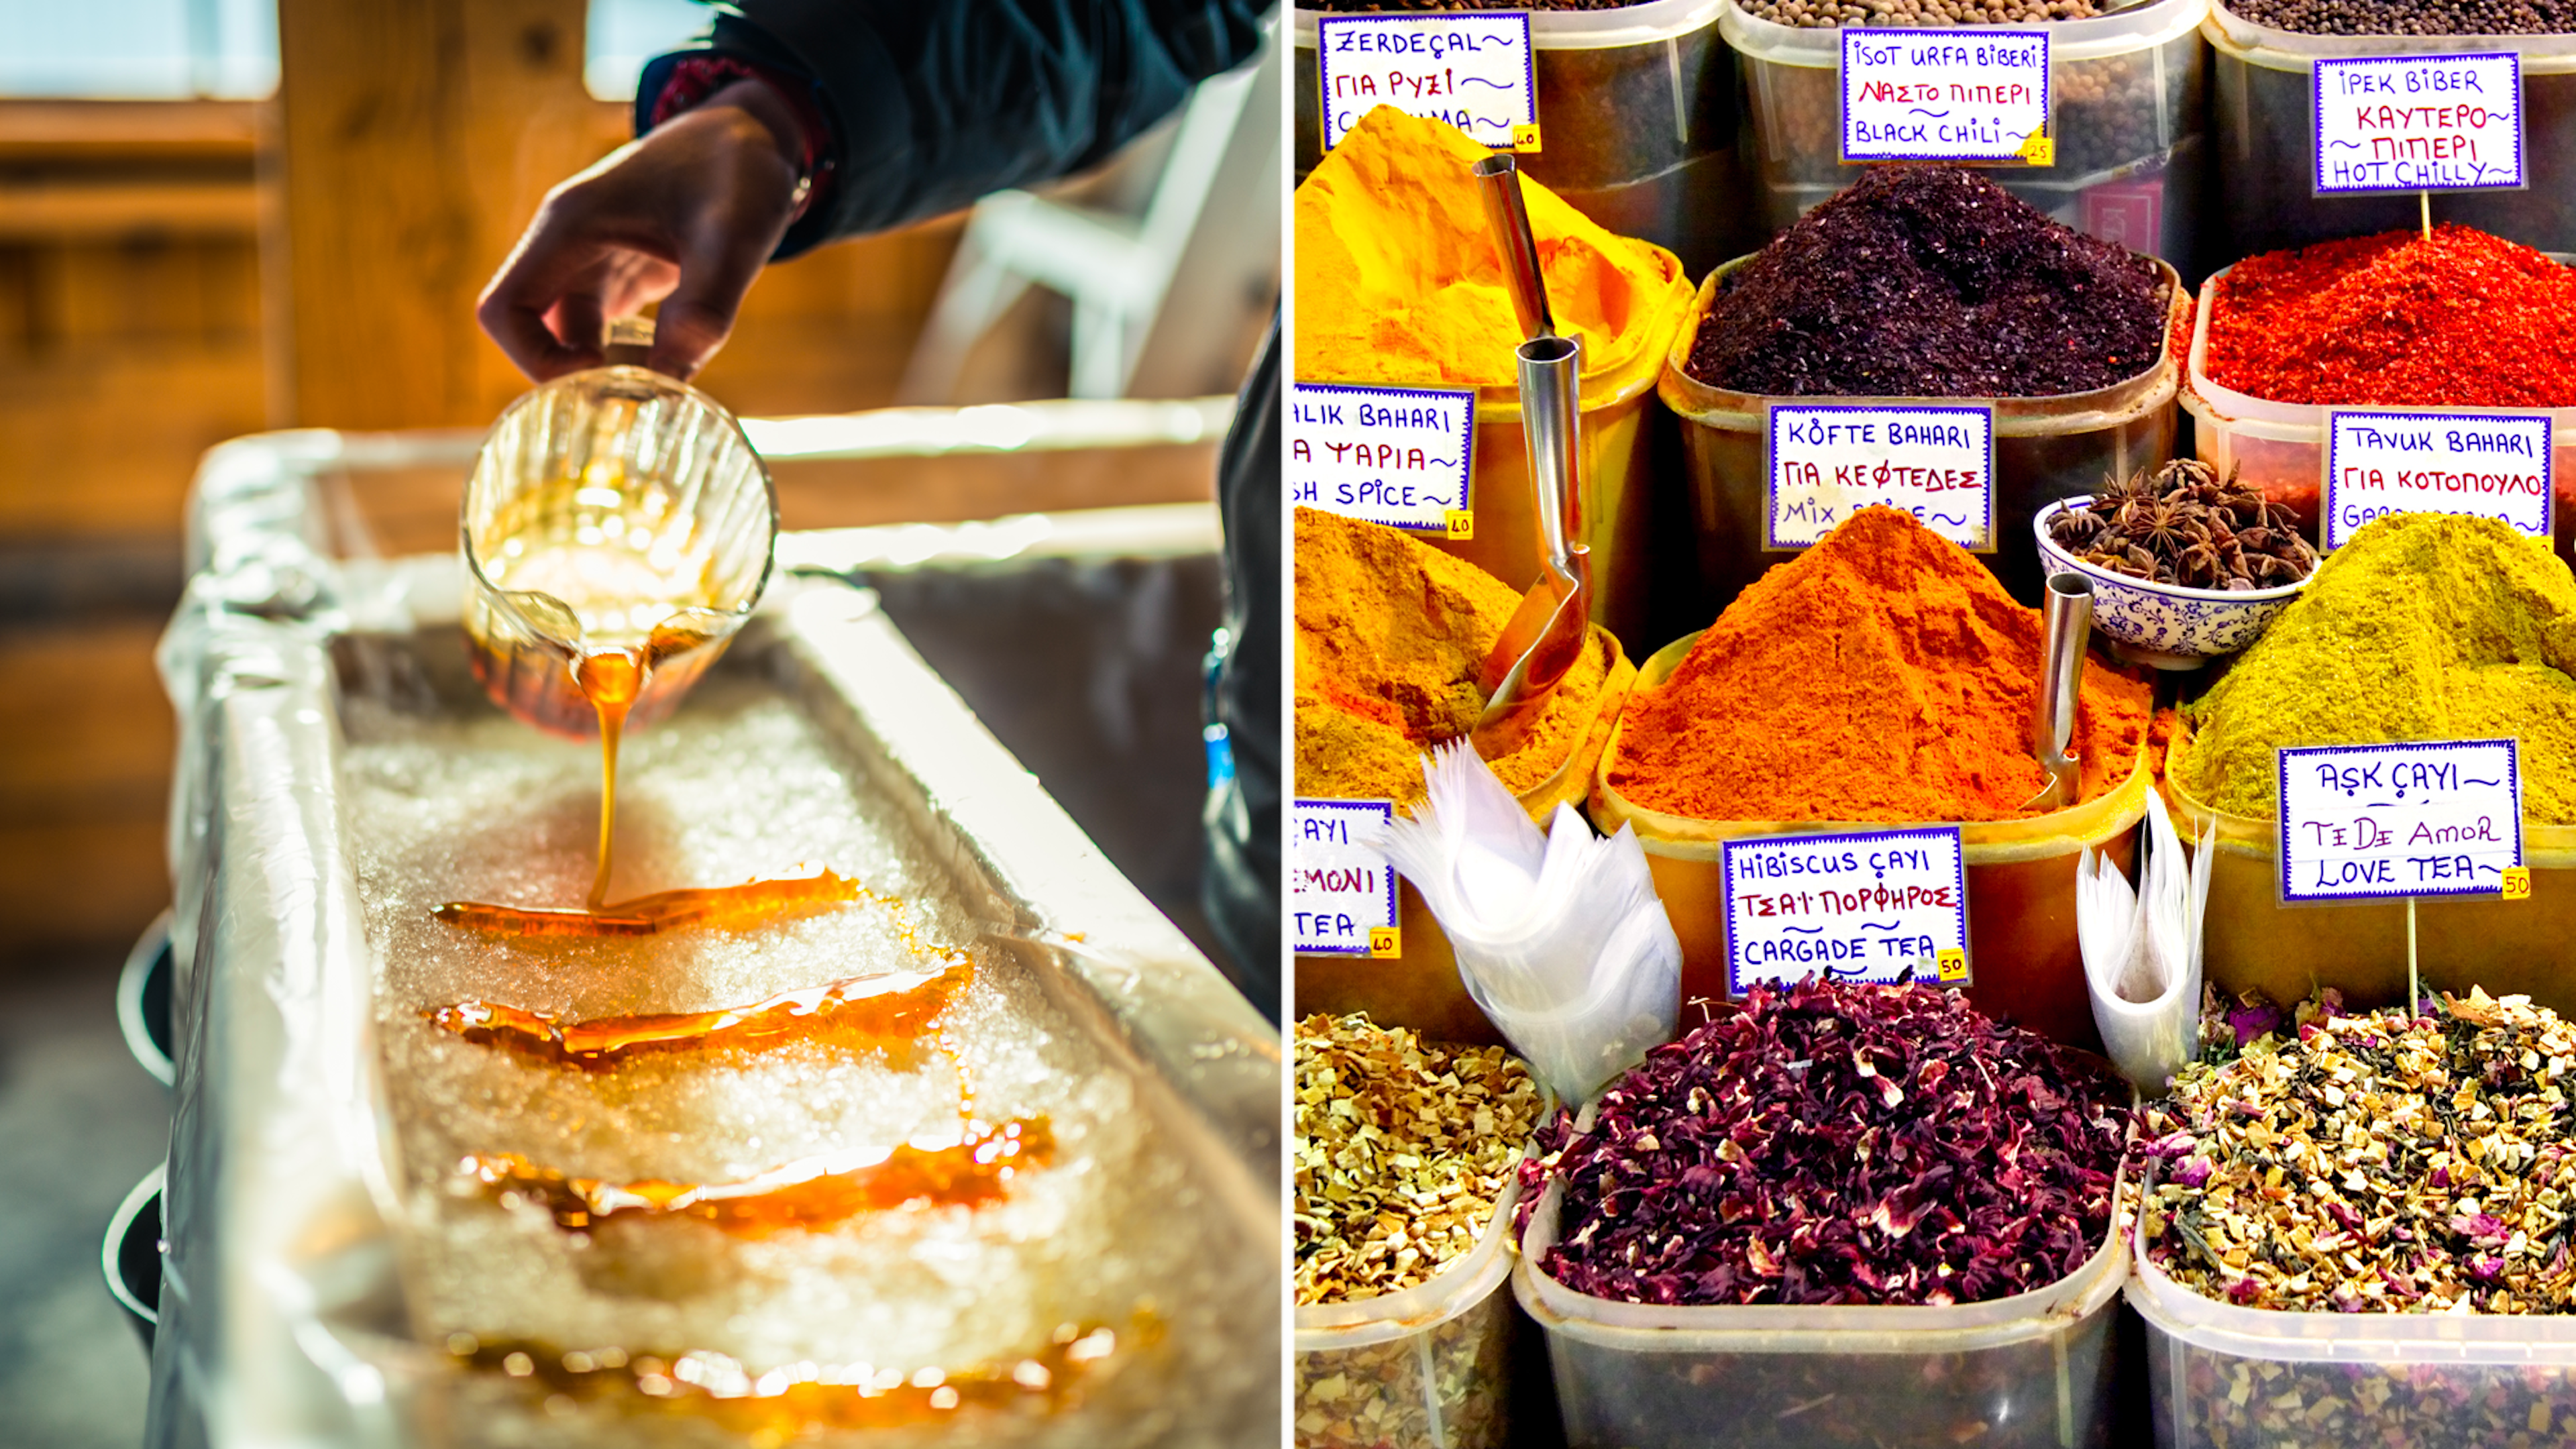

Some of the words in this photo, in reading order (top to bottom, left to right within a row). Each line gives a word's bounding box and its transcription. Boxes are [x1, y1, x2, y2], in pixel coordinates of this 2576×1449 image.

[1335, 30, 1482, 60] ZERDEÇAL
[1911, 47, 1968, 66] URFA
[1336, 74, 1377, 98] ΓΙΑ
[1949, 84, 2030, 105] ΠΙΠΕΡΙ
[2357, 104, 2486, 130] ΚΑΥΤΕΡΟ
[1856, 121, 1928, 142] BLACK
[2029, 144, 2047, 158] 25
[2371, 135, 2477, 161] ΠΙΠΕΡΙ
[2334, 161, 2389, 183] HOT
[1359, 404, 1450, 433] BAHARI
[1888, 423, 1970, 449] BAHARI
[2345, 427, 2433, 451] TAVUK
[2446, 430, 2533, 458] BAHARI
[1784, 462, 1821, 486] ΓΙΑ
[1835, 459, 1983, 492] ΚΕΦΤΕΔΕΣ
[2344, 467, 2384, 490] ΓΙΑ
[2398, 470, 2541, 496] ΚΟΤΟΠΟΥΛΟ
[2392, 761, 2458, 798] ÇAYI
[1869, 850, 1930, 879] ÇAYI
[2316, 859, 2396, 888] LOVE
[2406, 855, 2474, 881] TEA
[2505, 876, 2529, 894] 50
[1294, 912, 1354, 937] TEA
[1744, 938, 1868, 965] CARGADE
[1878, 935, 1935, 959] TEA
[1941, 958, 1962, 973] 50
